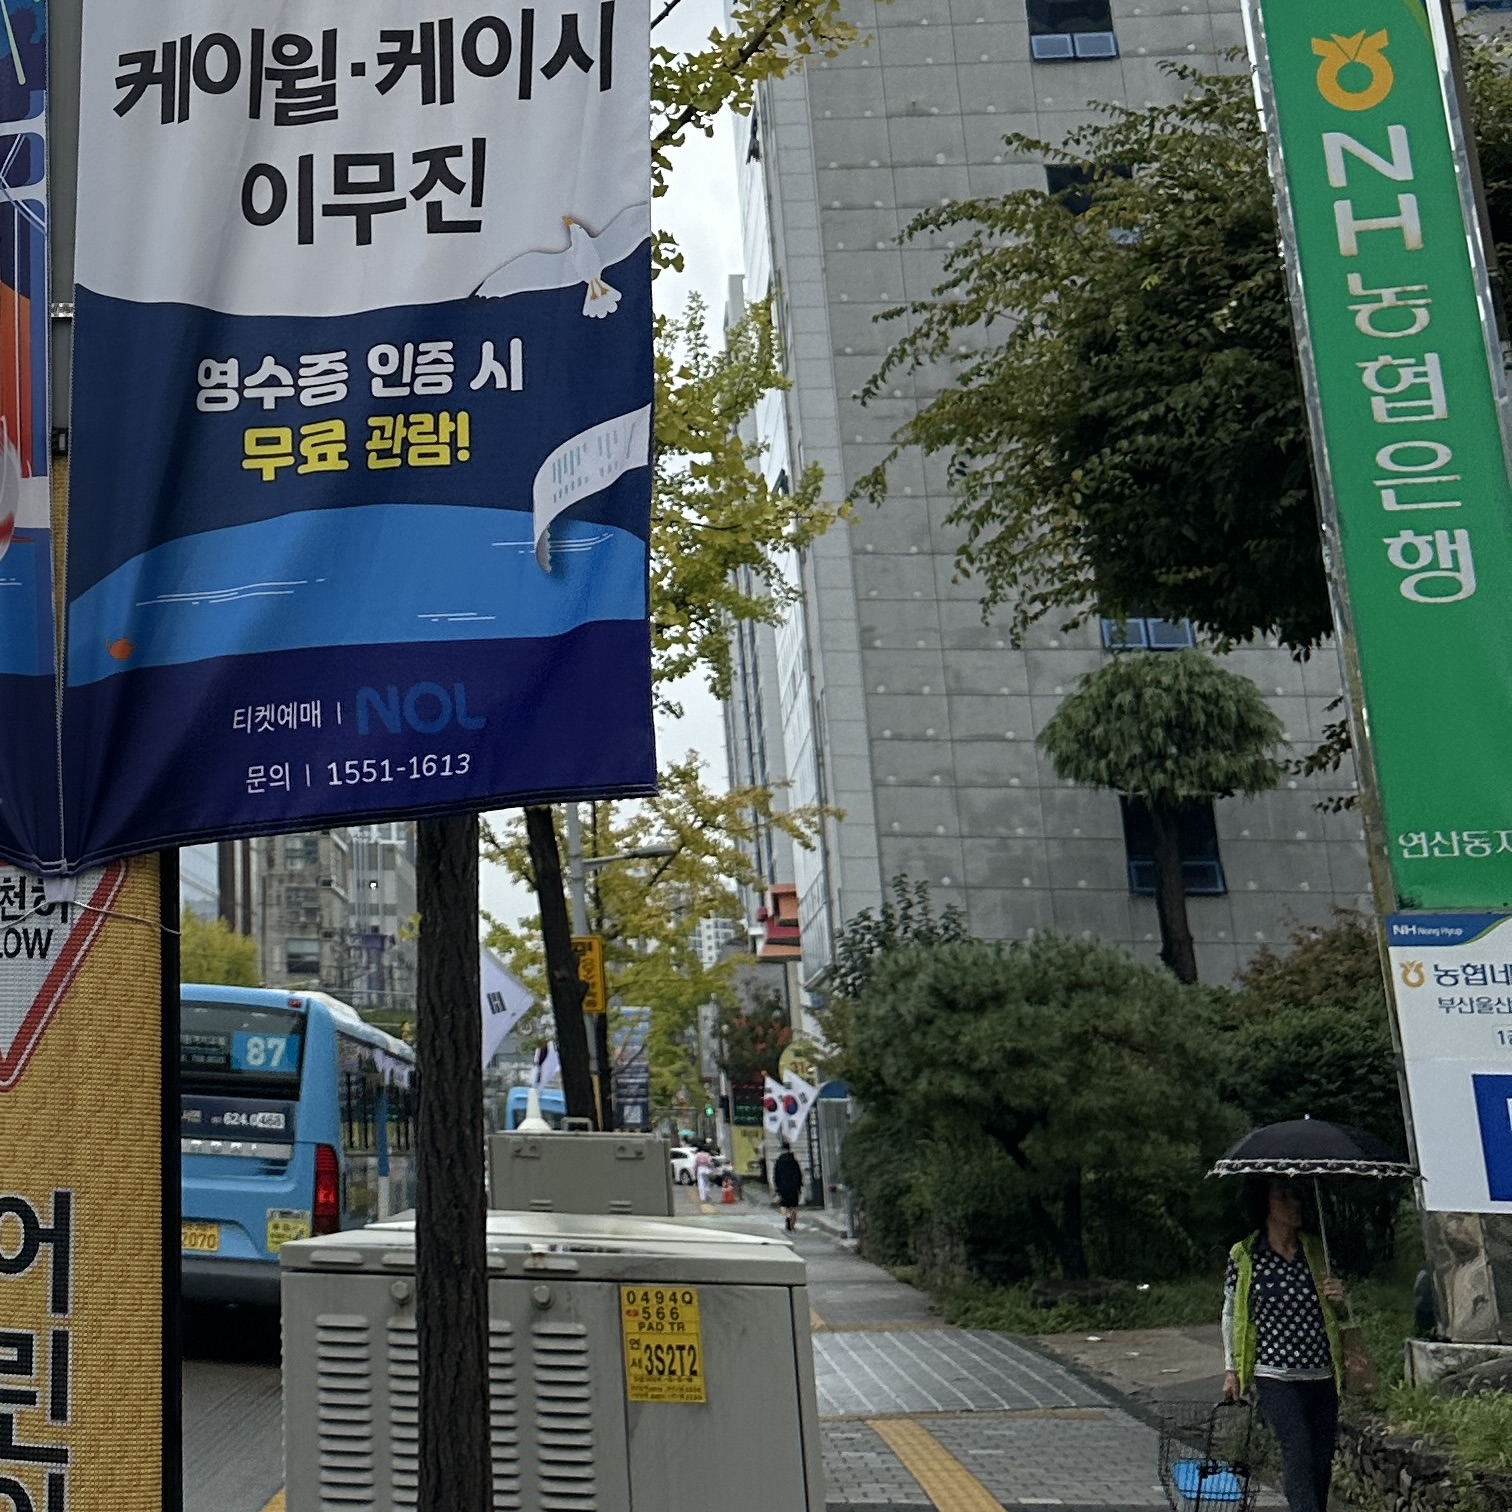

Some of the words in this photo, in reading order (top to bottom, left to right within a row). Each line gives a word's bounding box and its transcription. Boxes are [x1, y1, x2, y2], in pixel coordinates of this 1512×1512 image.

[241, 137, 488, 246] 이무진
[195, 350, 349, 413] 영수증
[366, 340, 455, 398] 인증
[469, 337, 524, 392] 시
[241, 418, 350, 483] 무료
[365, 410, 471, 471] 관람!
[232, 698, 322, 734] 티켓예매
[355, 680, 488, 737] NOL
[244, 761, 292, 795] 문의
[326, 753, 472, 787] 1551-1613
[246, 1036, 287, 1067] 87
[638, 1321, 664, 1332] PAD
[641, 1305, 679, 1321] 566
[644, 1344, 698, 1377] 3S2T2
